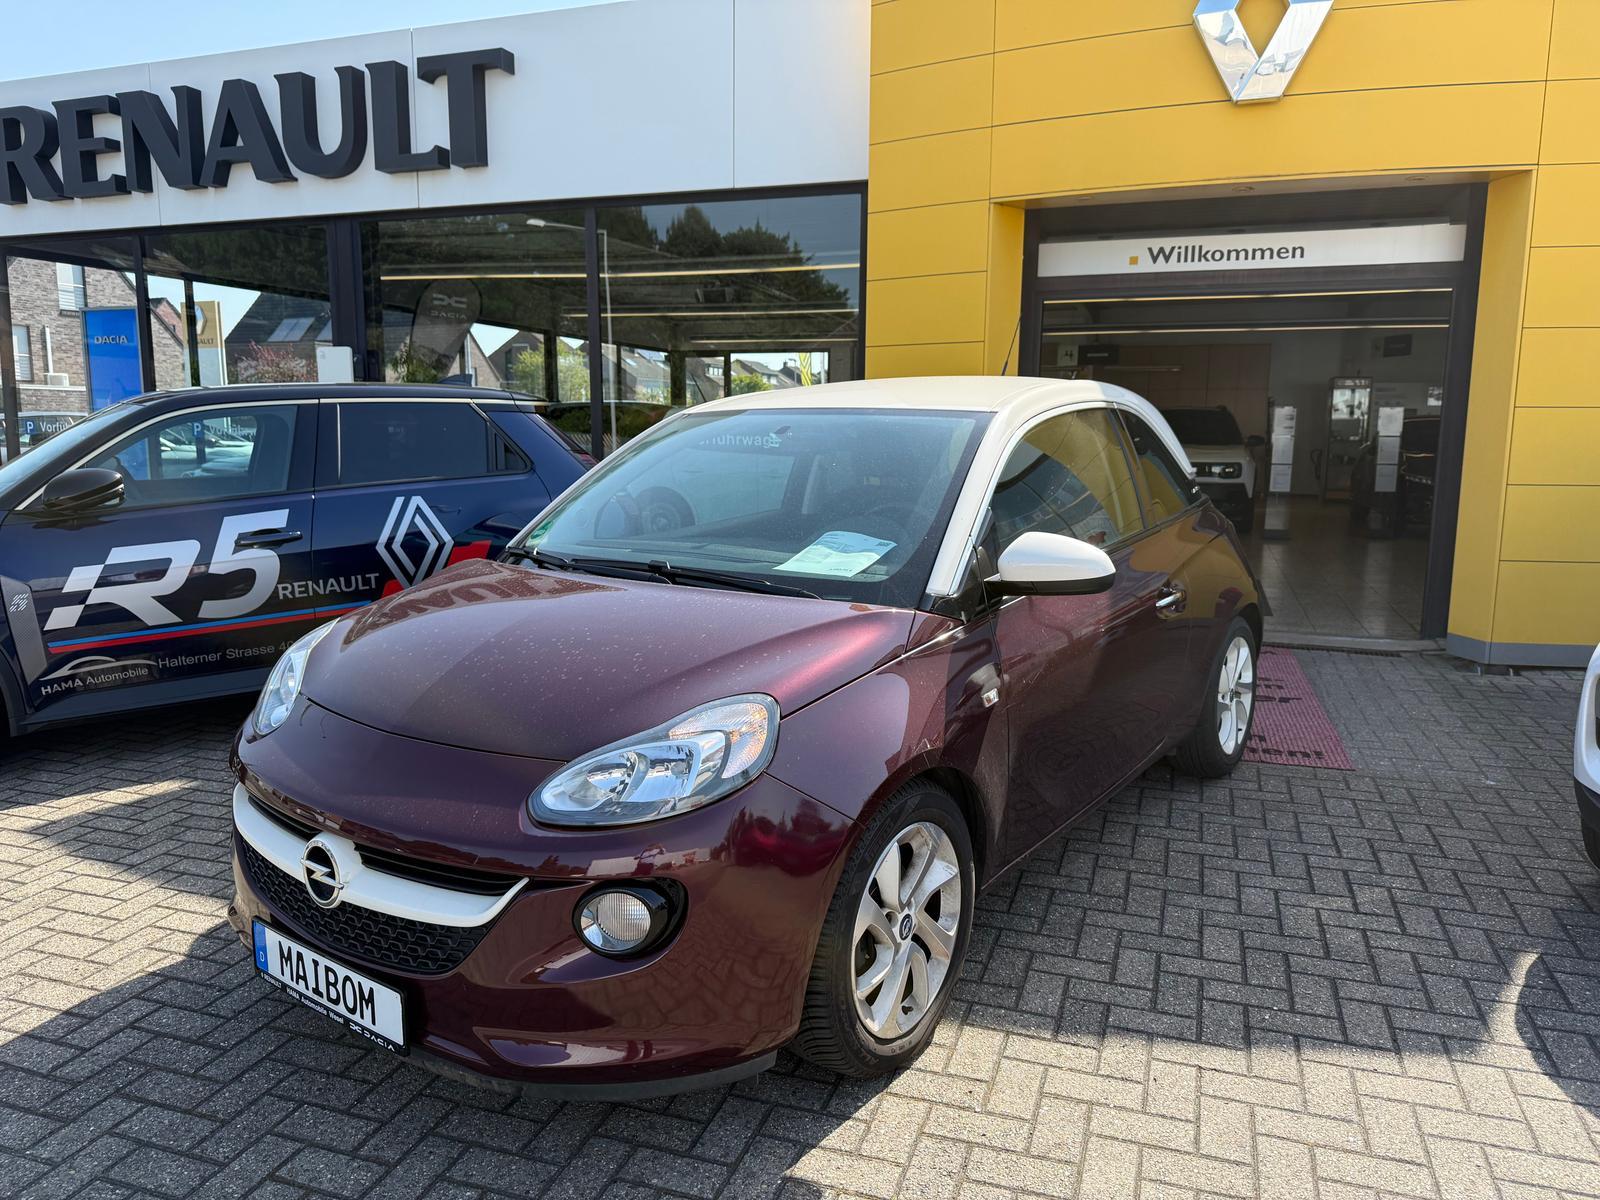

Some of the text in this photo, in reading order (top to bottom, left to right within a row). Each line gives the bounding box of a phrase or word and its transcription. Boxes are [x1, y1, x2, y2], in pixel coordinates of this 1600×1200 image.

[0, 47, 515, 205] RENAULT
[1147, 244, 1305, 265] Willkommen
[94, 335, 128, 345] DACIA
[26, 421, 34, 433] P
[43, 509, 290, 631] R5
[277, 573, 380, 600] RENAULT
[158, 653, 223, 669] Halterner
[225, 643, 275, 660] Strasse
[41, 666, 149, 696] HAMA Automobile
[278, 940, 376, 1026] MAIBOM
[363, 1031, 395, 1052] DACIA
